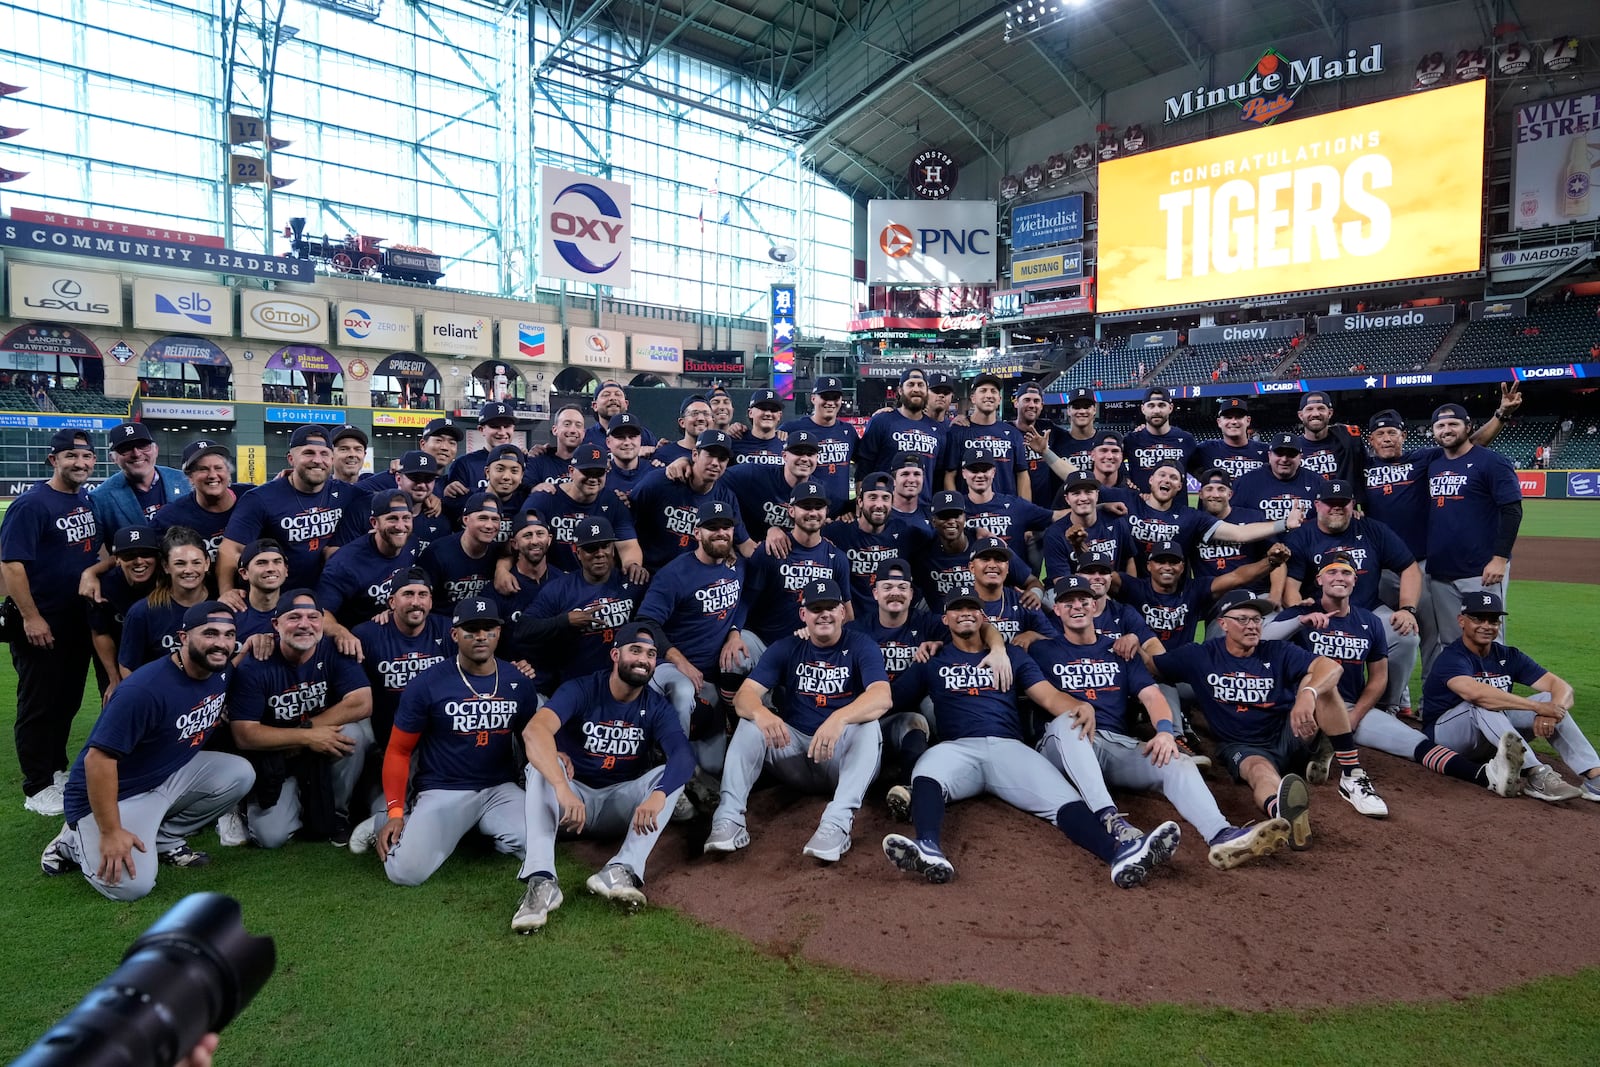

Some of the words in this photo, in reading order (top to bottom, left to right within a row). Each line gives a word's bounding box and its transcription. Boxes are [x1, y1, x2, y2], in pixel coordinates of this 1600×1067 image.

[1163, 72, 1281, 123] Minute
[1288, 43, 1384, 87] Maid
[1241, 95, 1294, 123] Park
[237, 122, 257, 138] 17
[915, 150, 953, 166] HOUSTON
[1170, 130, 1381, 185] CONGRATULATIONS
[237, 163, 257, 177] 22
[916, 184, 951, 198] ASTROS
[1017, 210, 1077, 234] Methodist
[1158, 153, 1393, 281] TIGERS
[45, 214, 129, 233] MINUTE
[146, 229, 196, 242] MAID
[550, 211, 624, 245] OXY
[917, 229, 990, 255] PNC
[31, 230, 192, 261] COMMUNITY
[204, 252, 300, 275] LEADERS
[1519, 246, 1580, 263] NABORS
[1020, 261, 1059, 275] MUSTANG
[1063, 257, 1080, 270] CAT
[24, 297, 109, 314] LEXUS
[178, 292, 211, 312] slb
[260, 306, 310, 328] COTTON
[1344, 310, 1424, 330] Silverado
[344, 319, 372, 329] OXY
[377, 322, 397, 332] ZERO
[433, 322, 478, 339] reliant
[518, 322, 545, 332] Chevron
[874, 331, 908, 339] HORNITOS
[1223, 327, 1268, 341] Chevy
[13, 343, 60, 352] CRAWFORD
[164, 345, 211, 359] RELENTLESS
[650, 345, 679, 363] LNG
[297, 353, 324, 364] planet
[301, 360, 329, 370] fitness
[389, 360, 411, 370] SPACE
[411, 361, 426, 372] CITY
[585, 355, 611, 364] QUANTA
[684, 360, 744, 374] Budweiser
[923, 368, 957, 377] mpact
[1395, 375, 1432, 384] HOUSTON
[277, 411, 337, 421] 1POINTFIVE
[398, 416, 415, 424] PAPA
[892, 431, 938, 447] OCTOBER
[898, 440, 935, 454] READY
[964, 439, 1011, 449] OCTOBER
[1135, 448, 1184, 458] OCTOBER
[1213, 458, 1264, 469] OCTOBER
[1299, 455, 1337, 468] OCTOB
[1307, 462, 1337, 474] READ
[1364, 463, 1414, 478] OCTOBER
[1366, 471, 1409, 487] READY
[281, 508, 343, 530] OCTOBER
[1129, 514, 1180, 535] OCTOBER
[66, 524, 97, 543] READ
[288, 518, 340, 542] READY
[847, 547, 898, 563] OCTOBER
[1200, 545, 1243, 559] READY
[779, 564, 833, 580] OCTOBER
[851, 561, 878, 574] REA
[784, 576, 809, 590] REA
[930, 569, 975, 584] OCTOB
[695, 580, 740, 601] OCTOBER
[702, 590, 739, 613] READY
[1141, 603, 1189, 619] OCTOBER
[1145, 615, 1186, 631] READY
[1309, 631, 1369, 649] OCTOBER
[1313, 642, 1364, 661] READY
[796, 663, 850, 680] OCTOBER
[1053, 661, 1121, 676] OCTOBER
[384, 673, 419, 689] REA
[798, 675, 846, 694] READY
[1061, 674, 1116, 690] READY
[1207, 673, 1275, 688] OCTOBER
[268, 681, 328, 707] OCTOBER
[1213, 686, 1271, 703] READY
[176, 692, 227, 730] OCTOBER
[274, 693, 327, 721] READY
[445, 700, 518, 716] OCTOBER
[178, 708, 223, 742] READY
[453, 714, 513, 733] READY
[582, 721, 645, 741] OCTOBER
[583, 734, 640, 756] READY
